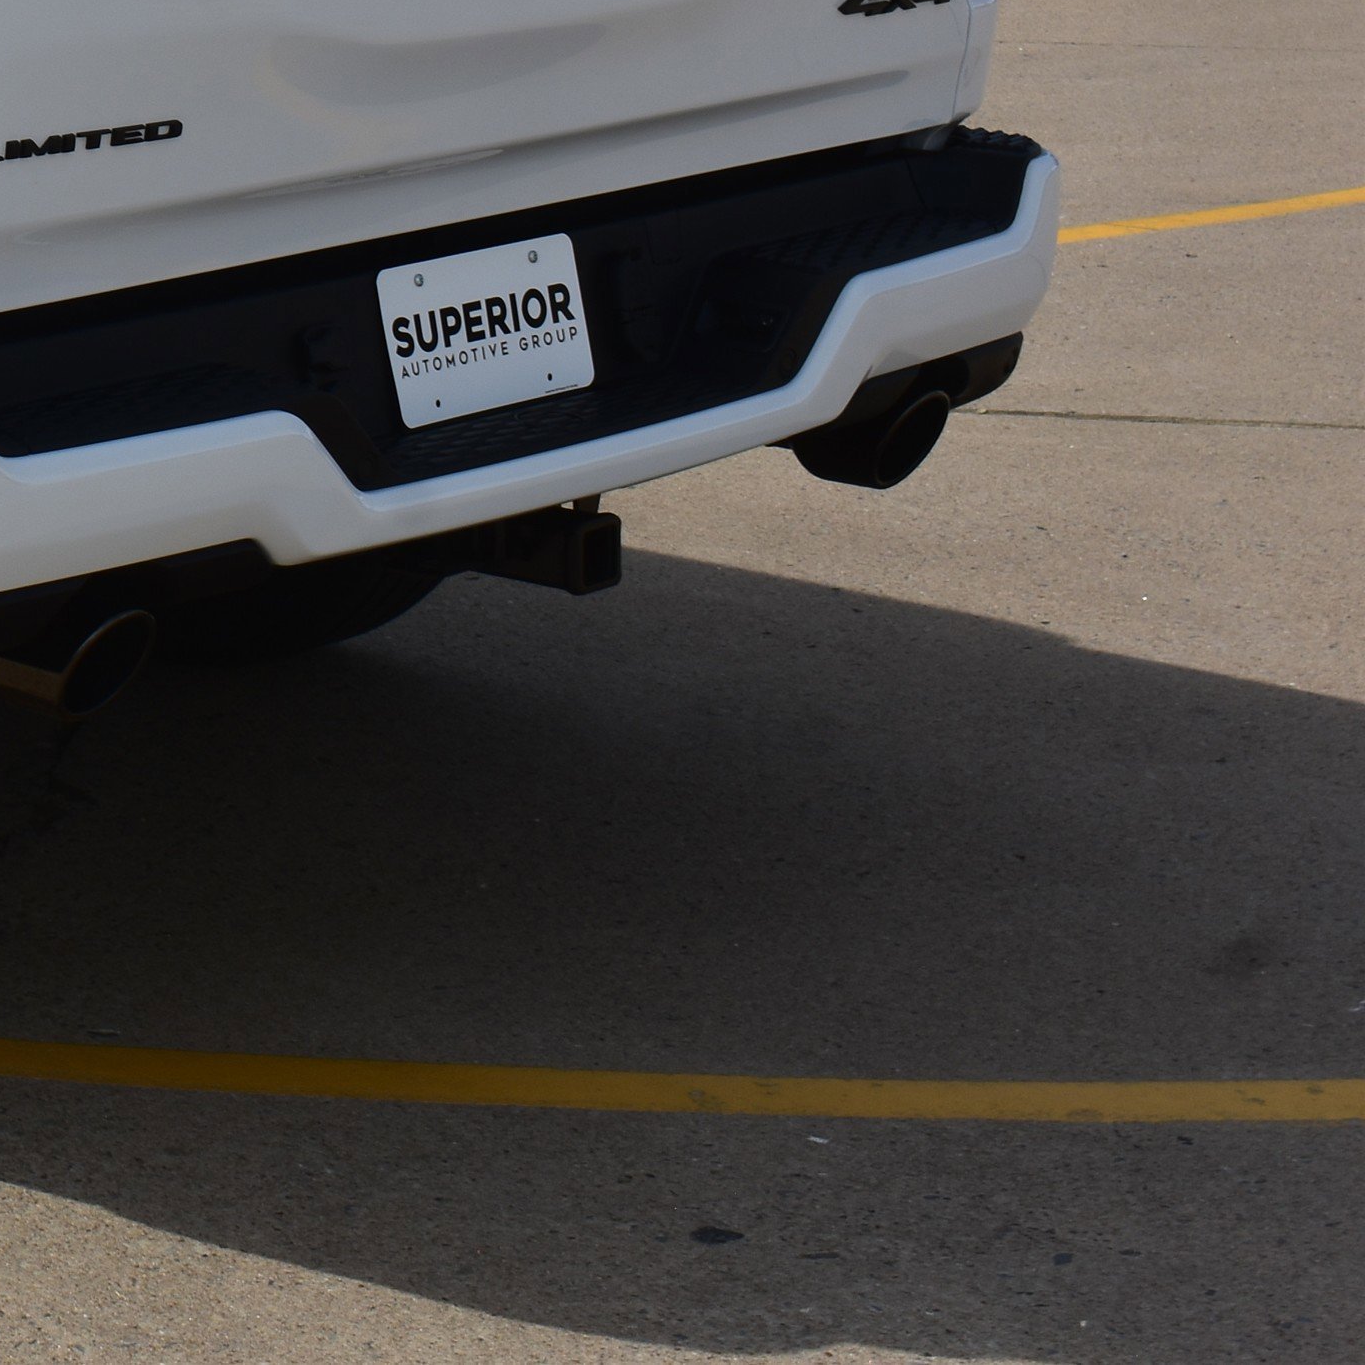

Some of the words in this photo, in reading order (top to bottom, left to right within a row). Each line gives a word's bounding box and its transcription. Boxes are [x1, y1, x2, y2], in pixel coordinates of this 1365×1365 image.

[391, 283, 575, 358] SUPERIOR
[401, 341, 509, 379] AUTOMOTIVE
[519, 326, 578, 351] GROUP
